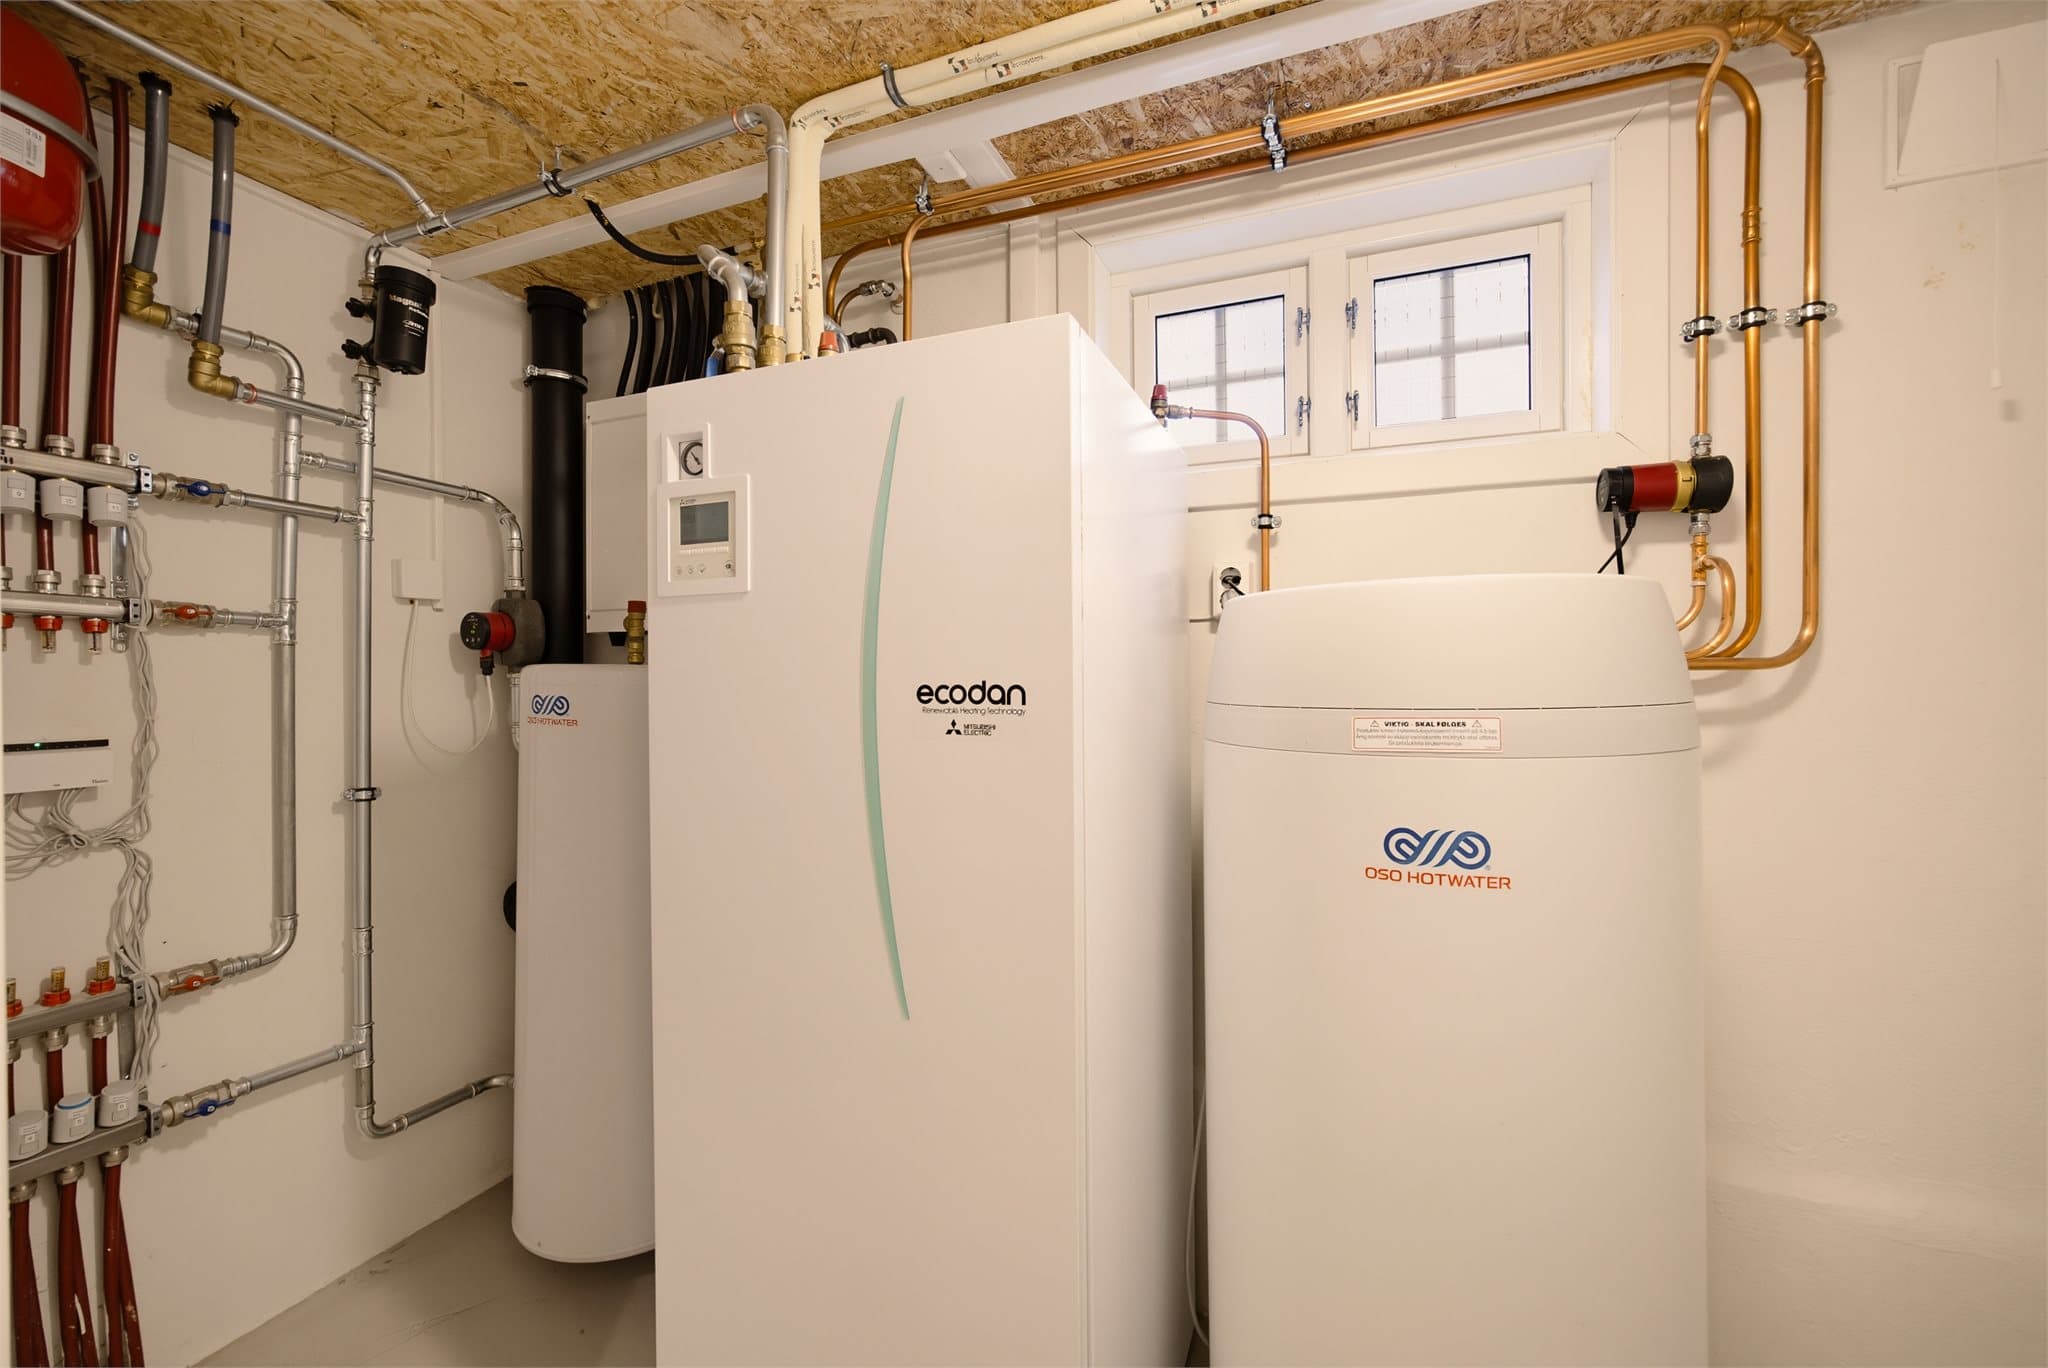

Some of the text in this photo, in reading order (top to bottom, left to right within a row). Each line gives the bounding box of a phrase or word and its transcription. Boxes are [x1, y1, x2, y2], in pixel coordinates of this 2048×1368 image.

[916, 680, 1026, 705] ecodan
[922, 706, 1026, 717] Renewable Heating Technology
[1365, 866, 1511, 890] OSO HOTWATER
